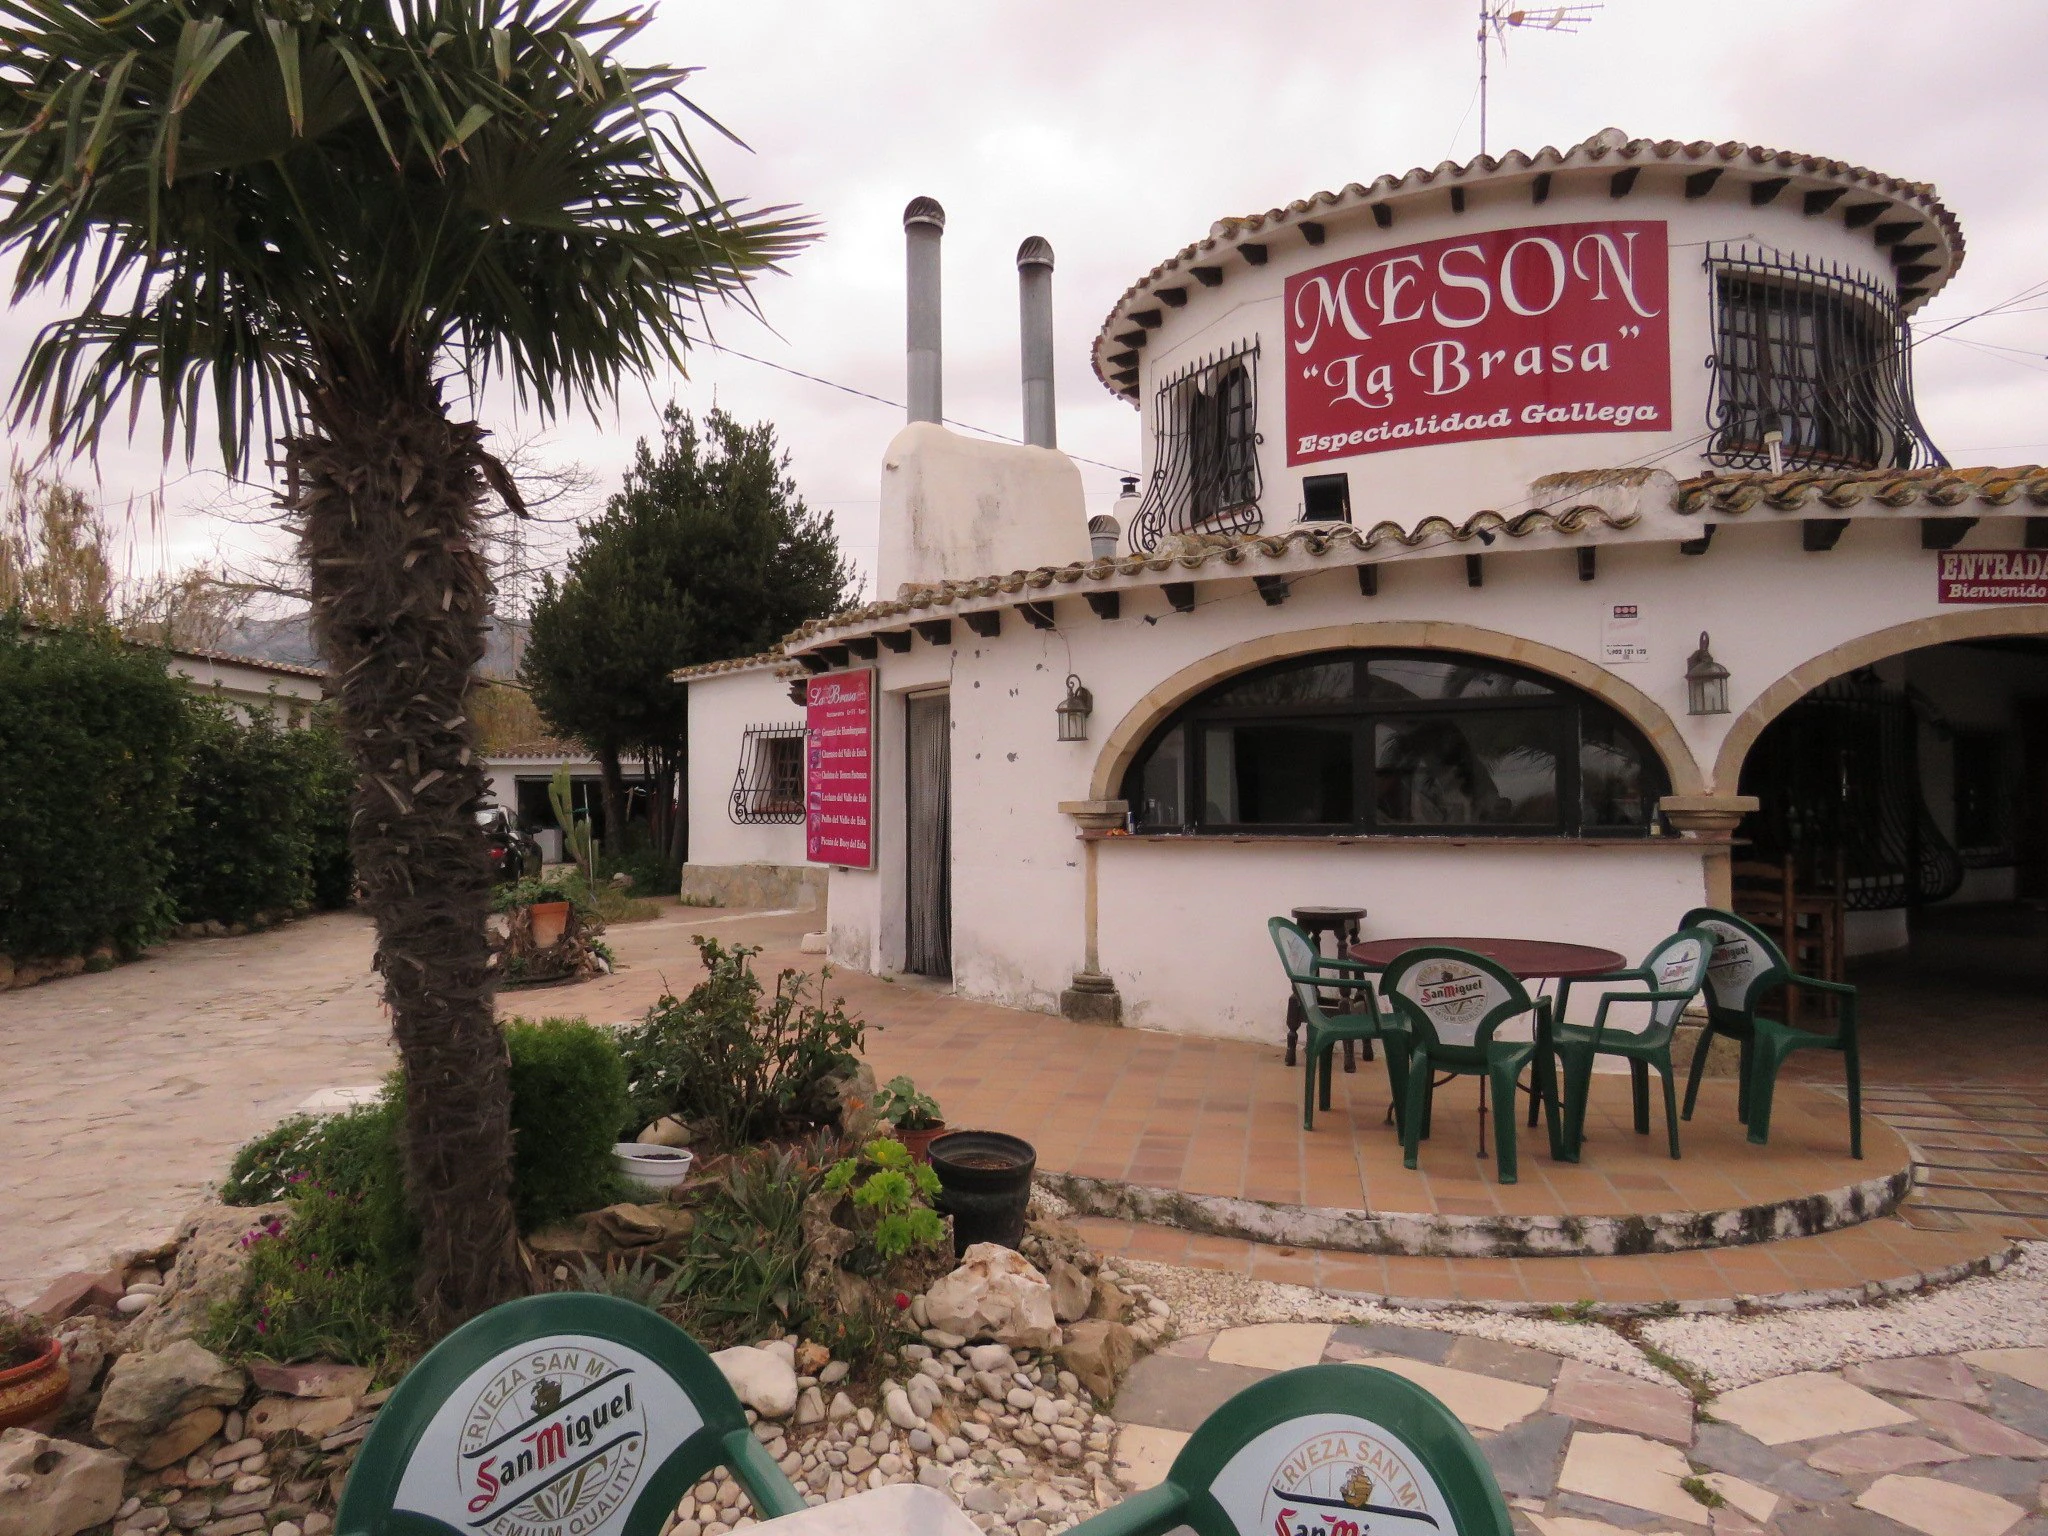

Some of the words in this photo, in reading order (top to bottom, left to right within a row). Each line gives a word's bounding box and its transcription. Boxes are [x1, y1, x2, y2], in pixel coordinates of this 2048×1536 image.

[1294, 232, 1661, 355] MESON
[1296, 408, 1513, 456] Especialidad
[1520, 402, 1659, 426] Gallega
[1948, 583, 2047, 598] Bienvenido
[809, 687, 825, 706] La
[531, 1352, 579, 1375] SAN
[585, 1357, 613, 1378] M
[569, 1457, 637, 1535] QUALITY
[1355, 1440, 1400, 1482] SAN
[1396, 1480, 1422, 1510] M
